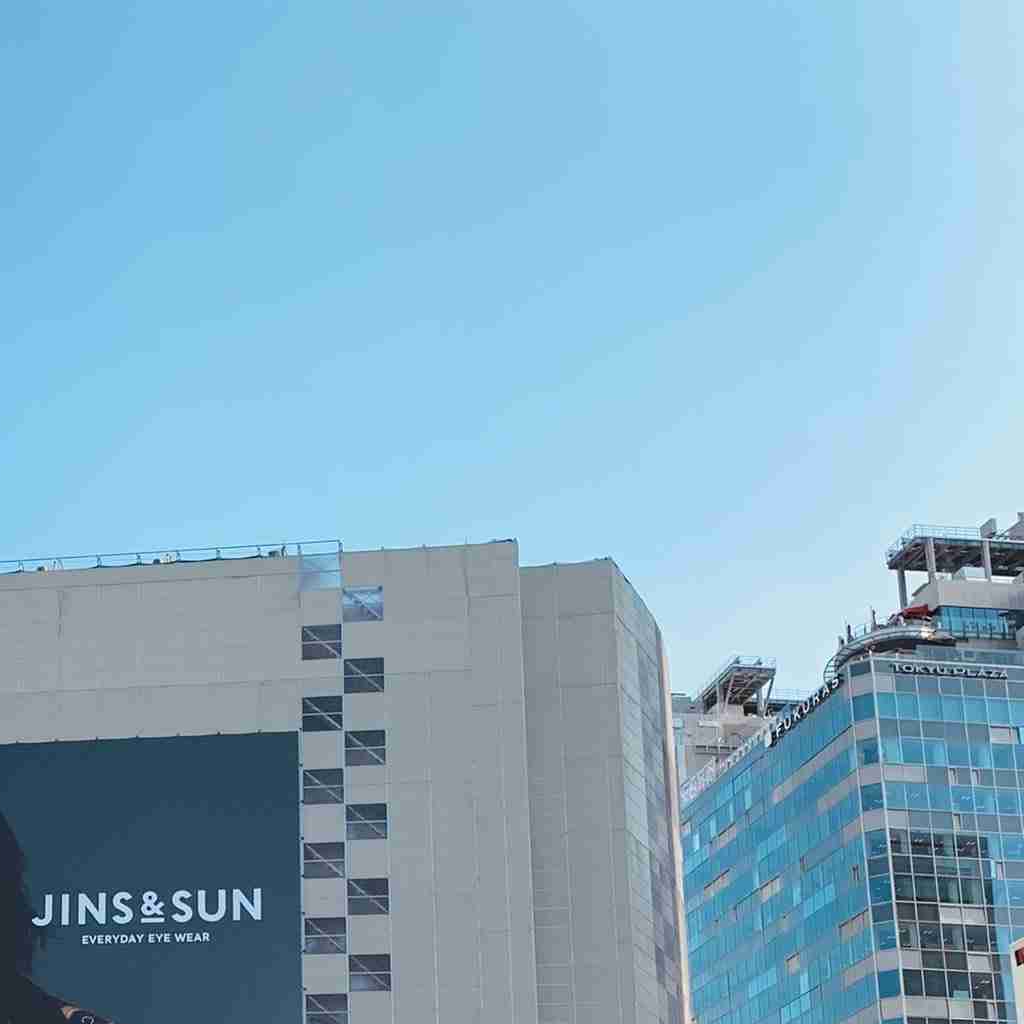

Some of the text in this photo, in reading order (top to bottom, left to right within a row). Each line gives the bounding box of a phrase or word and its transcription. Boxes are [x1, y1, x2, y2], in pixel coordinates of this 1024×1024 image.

[893, 662, 1009, 679] TOKYU PLAZA
[31, 887, 263, 927] JINS&SUN
[81, 931, 211, 945] EVERYDAY EYE WEAR
